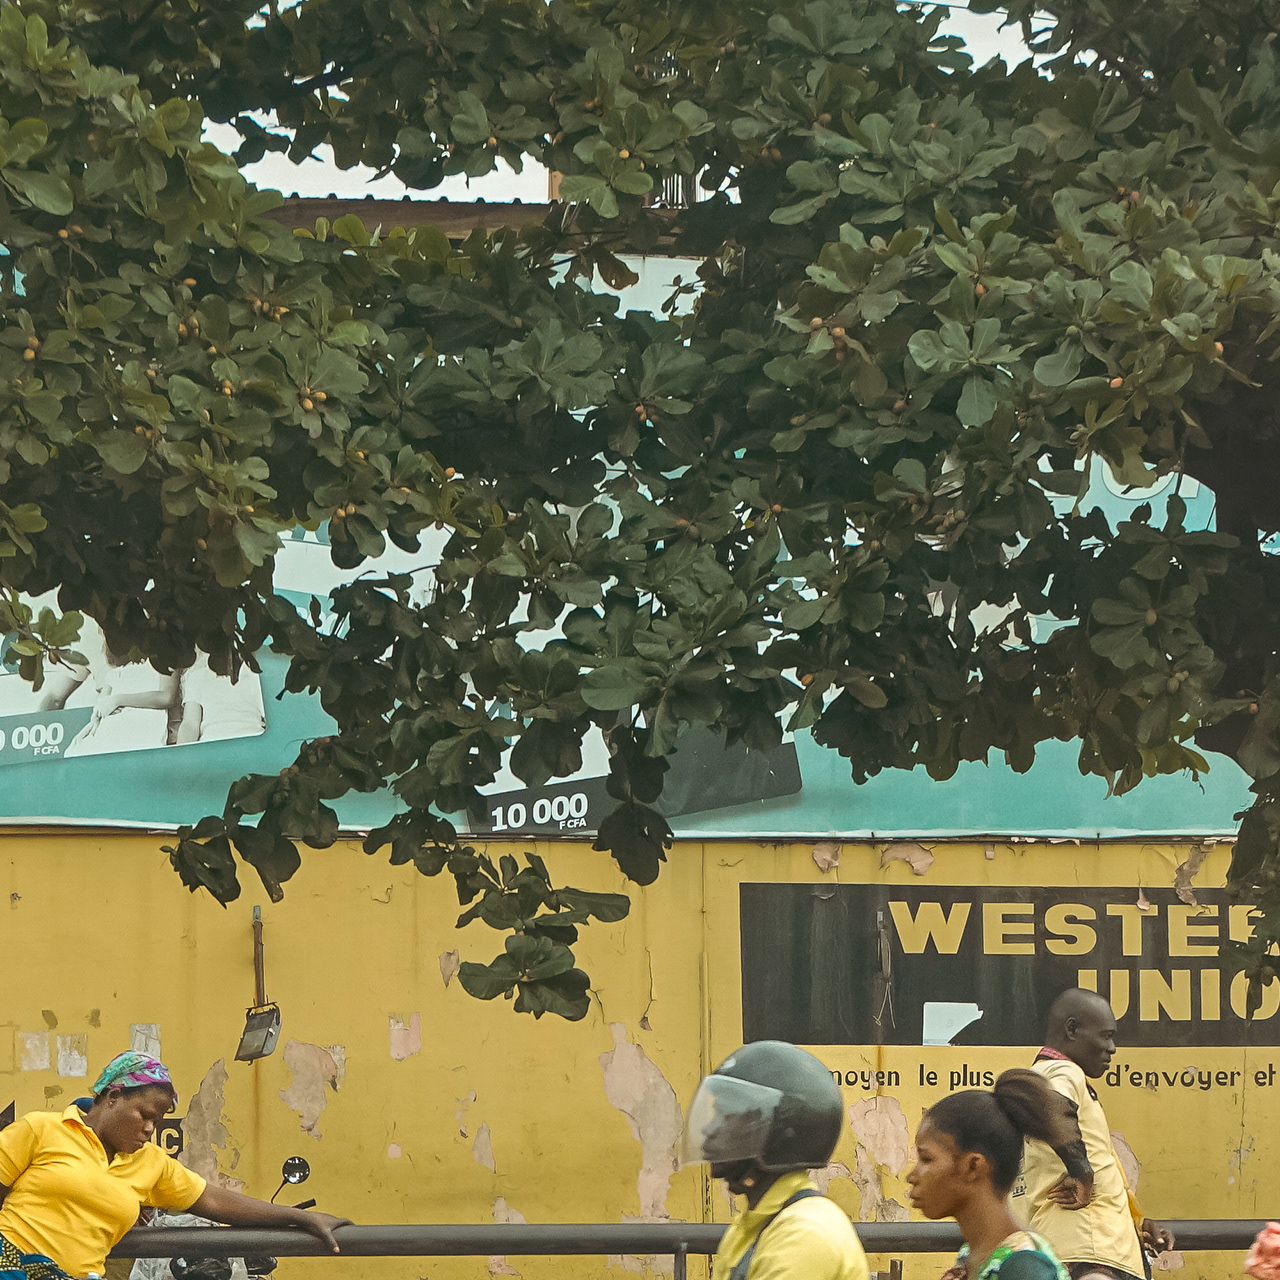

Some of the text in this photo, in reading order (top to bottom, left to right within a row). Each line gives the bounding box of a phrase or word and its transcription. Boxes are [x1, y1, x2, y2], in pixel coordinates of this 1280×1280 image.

[11, 722, 64, 749] 000
[33, 745, 60, 756] F CFA
[491, 792, 589, 832] 10 000
[559, 818, 587, 830] F CFA
[919, 1064, 938, 1087] le
[949, 1063, 995, 1091] plus
[1105, 1063, 1241, 1091] d'envoyer
[1254, 1063, 1277, 1087] et
